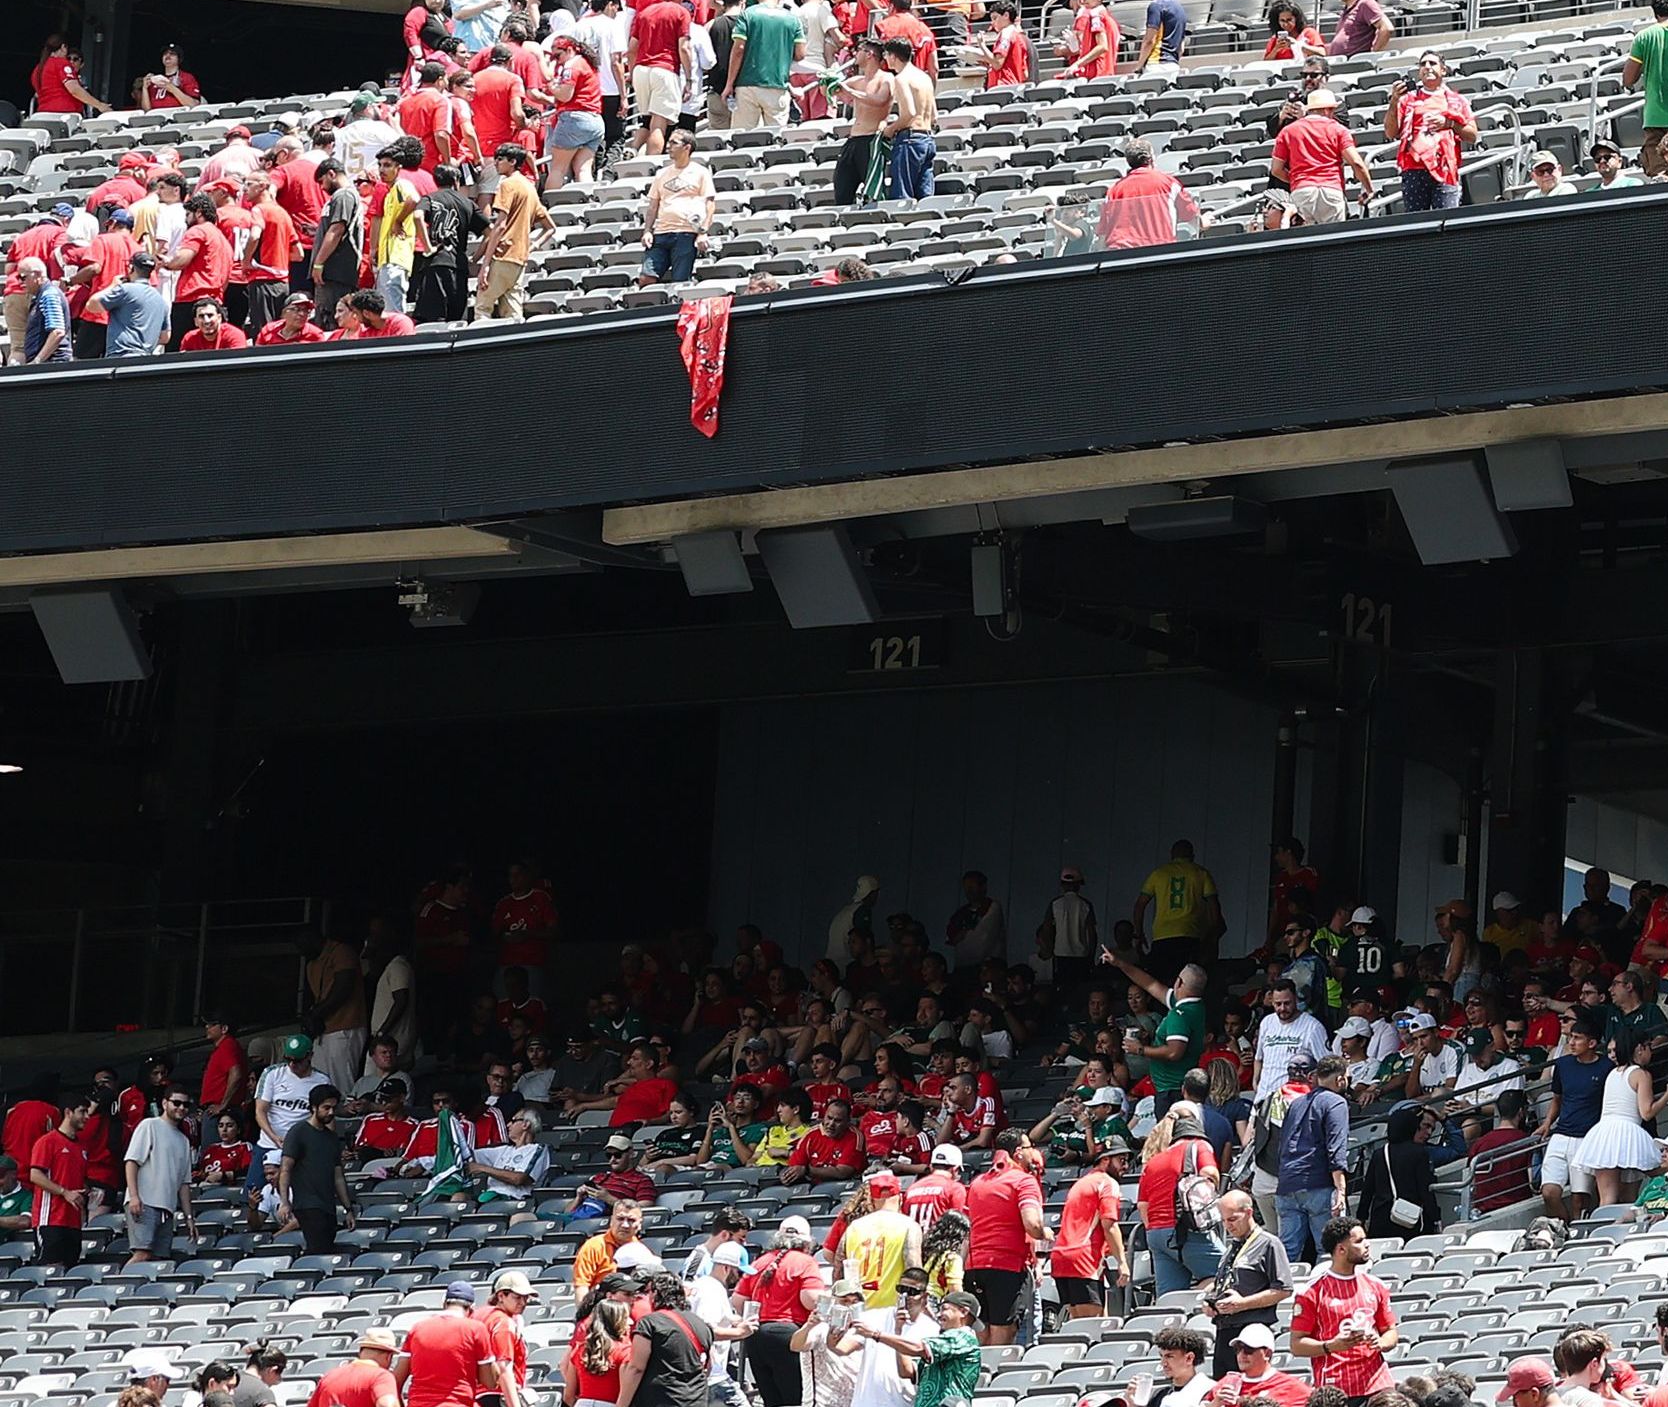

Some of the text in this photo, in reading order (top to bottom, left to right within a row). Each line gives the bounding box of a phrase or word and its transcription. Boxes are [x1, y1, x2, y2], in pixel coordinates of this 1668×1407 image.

[343, 142, 365, 174] 15
[1341, 592, 1392, 648] 121
[869, 635, 921, 670] 121
[1355, 945, 1382, 974] 10
[861, 1238, 886, 1278] 11
